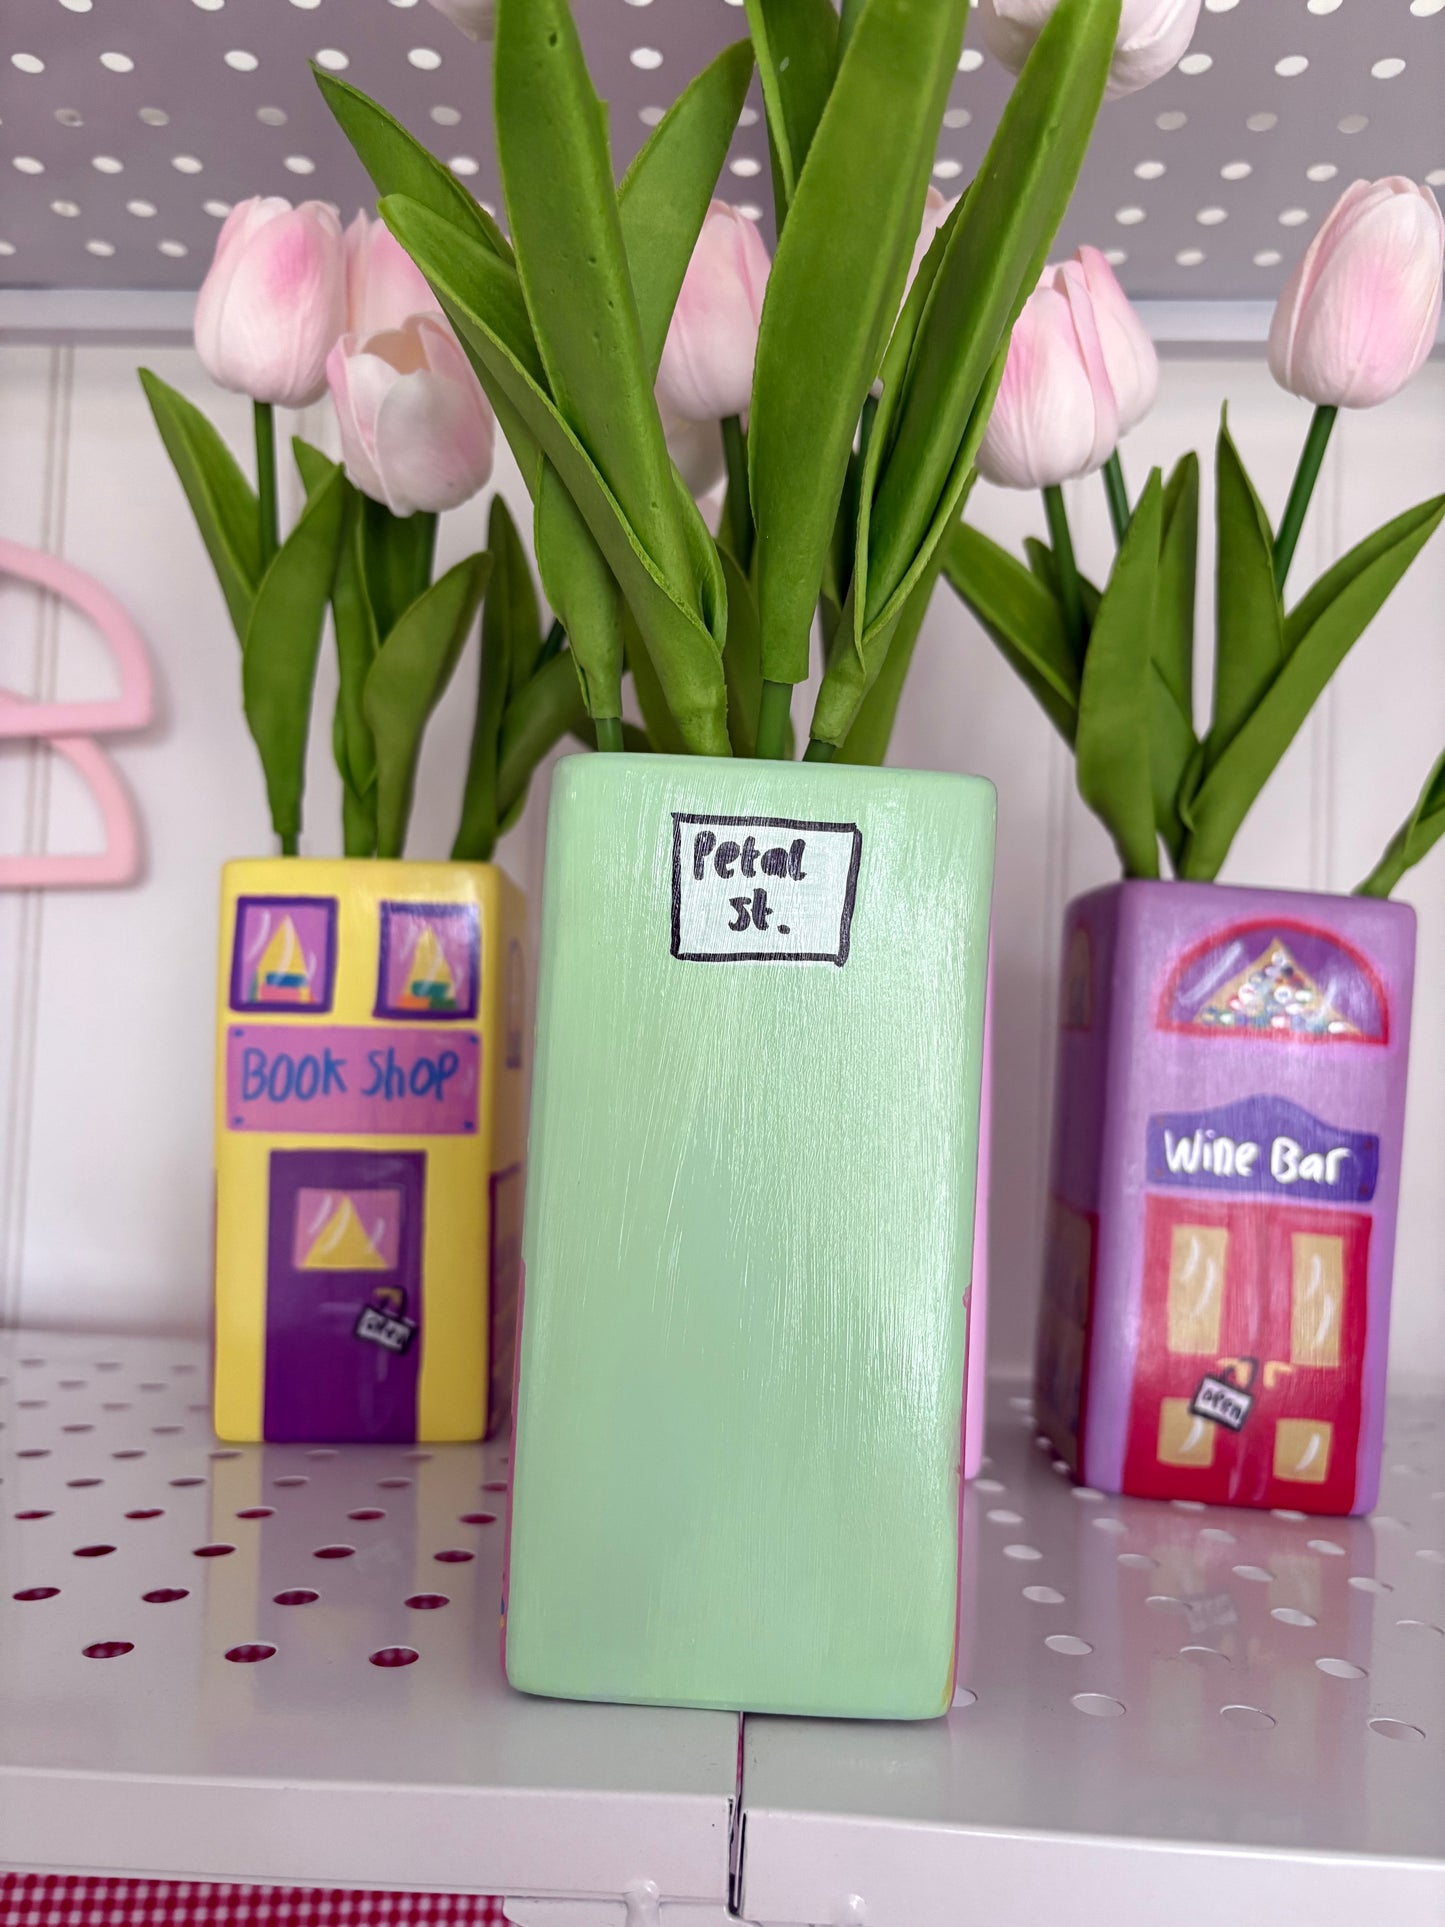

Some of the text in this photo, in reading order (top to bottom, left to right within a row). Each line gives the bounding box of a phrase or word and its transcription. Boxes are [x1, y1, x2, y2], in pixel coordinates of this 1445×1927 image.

[694, 830, 807, 881] Petal
[1164, 1129, 1352, 1185] Wine Bar
